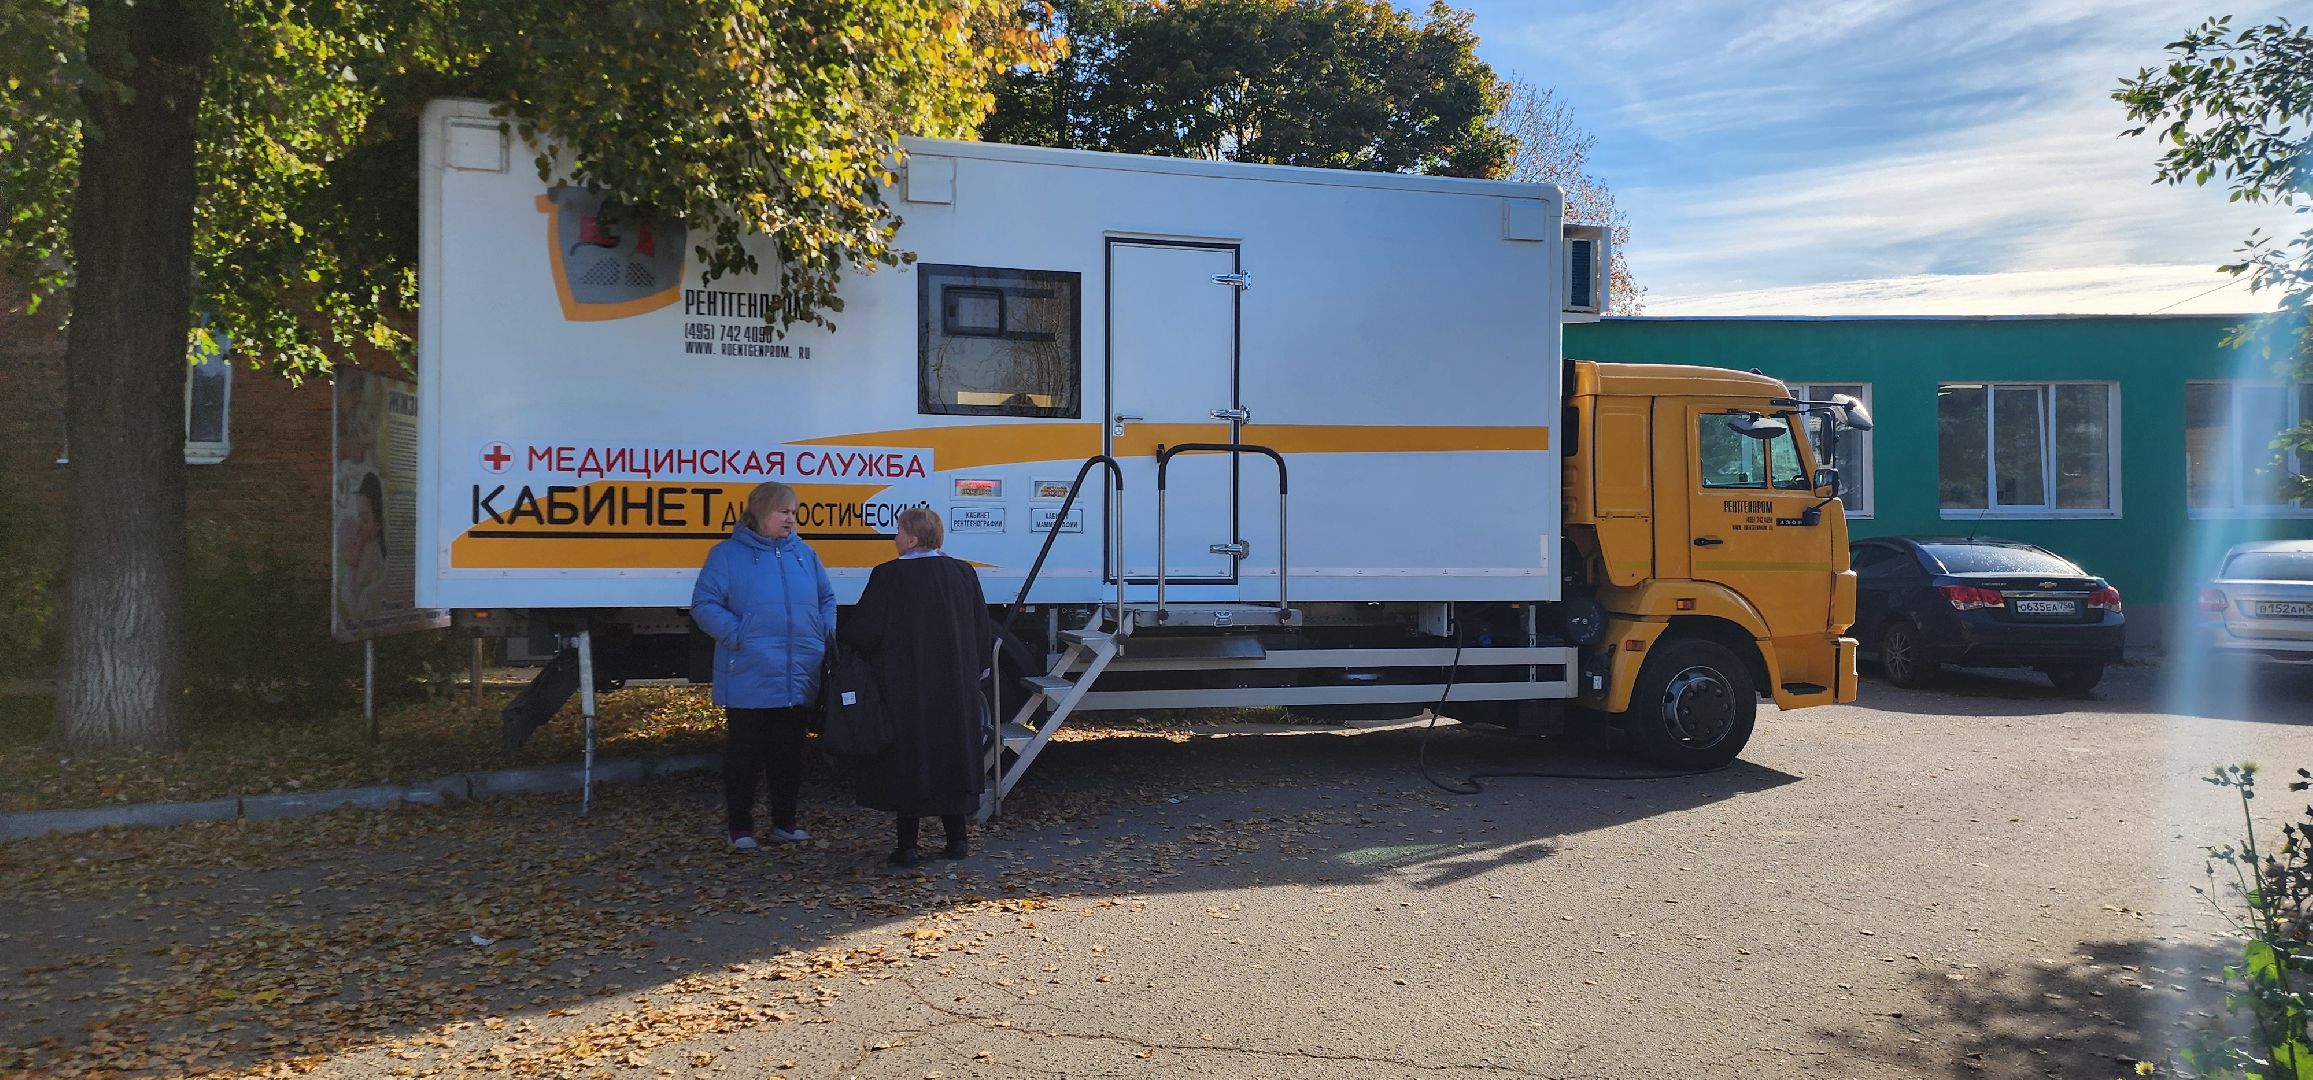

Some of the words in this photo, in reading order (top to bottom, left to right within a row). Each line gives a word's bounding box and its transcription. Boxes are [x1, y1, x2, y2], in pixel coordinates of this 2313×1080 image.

[685, 322, 715, 340] (495)
[720, 324, 741, 342] 742
[798, 346, 811, 360] RU
[528, 445, 785, 479] МЕДИЦИНСКАЯ
[796, 451, 926, 478] СЛУЖБА
[472, 484, 723, 526] КАБИНЕТ
[965, 511, 990, 519] КАБИНЕТ
